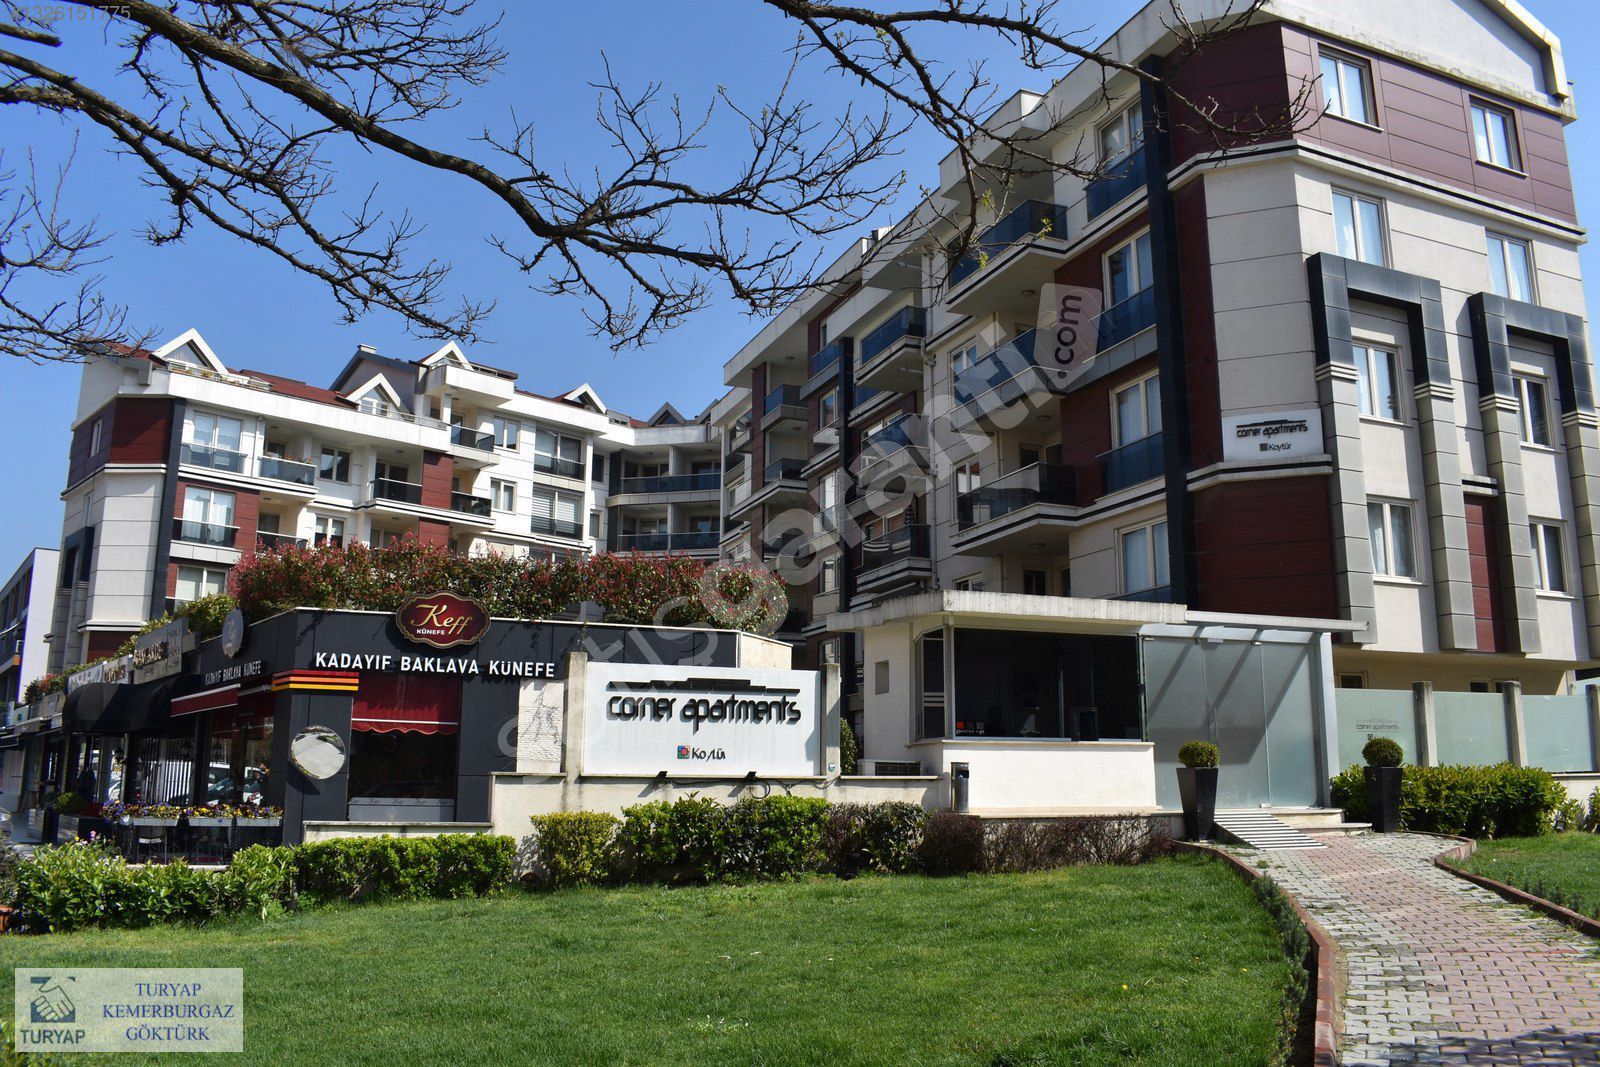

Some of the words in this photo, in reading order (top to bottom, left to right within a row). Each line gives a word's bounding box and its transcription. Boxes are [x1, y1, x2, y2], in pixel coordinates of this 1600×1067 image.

[1236, 427, 1261, 438] corner
[1263, 423, 1308, 439] apartments
[410, 602, 473, 636] Keff
[315, 652, 392, 671] KADAYIF
[400, 656, 479, 674] BAKLAVA
[489, 660, 555, 677] KÜNEFE
[607, 695, 677, 721] corner
[681, 694, 802, 734] apartments
